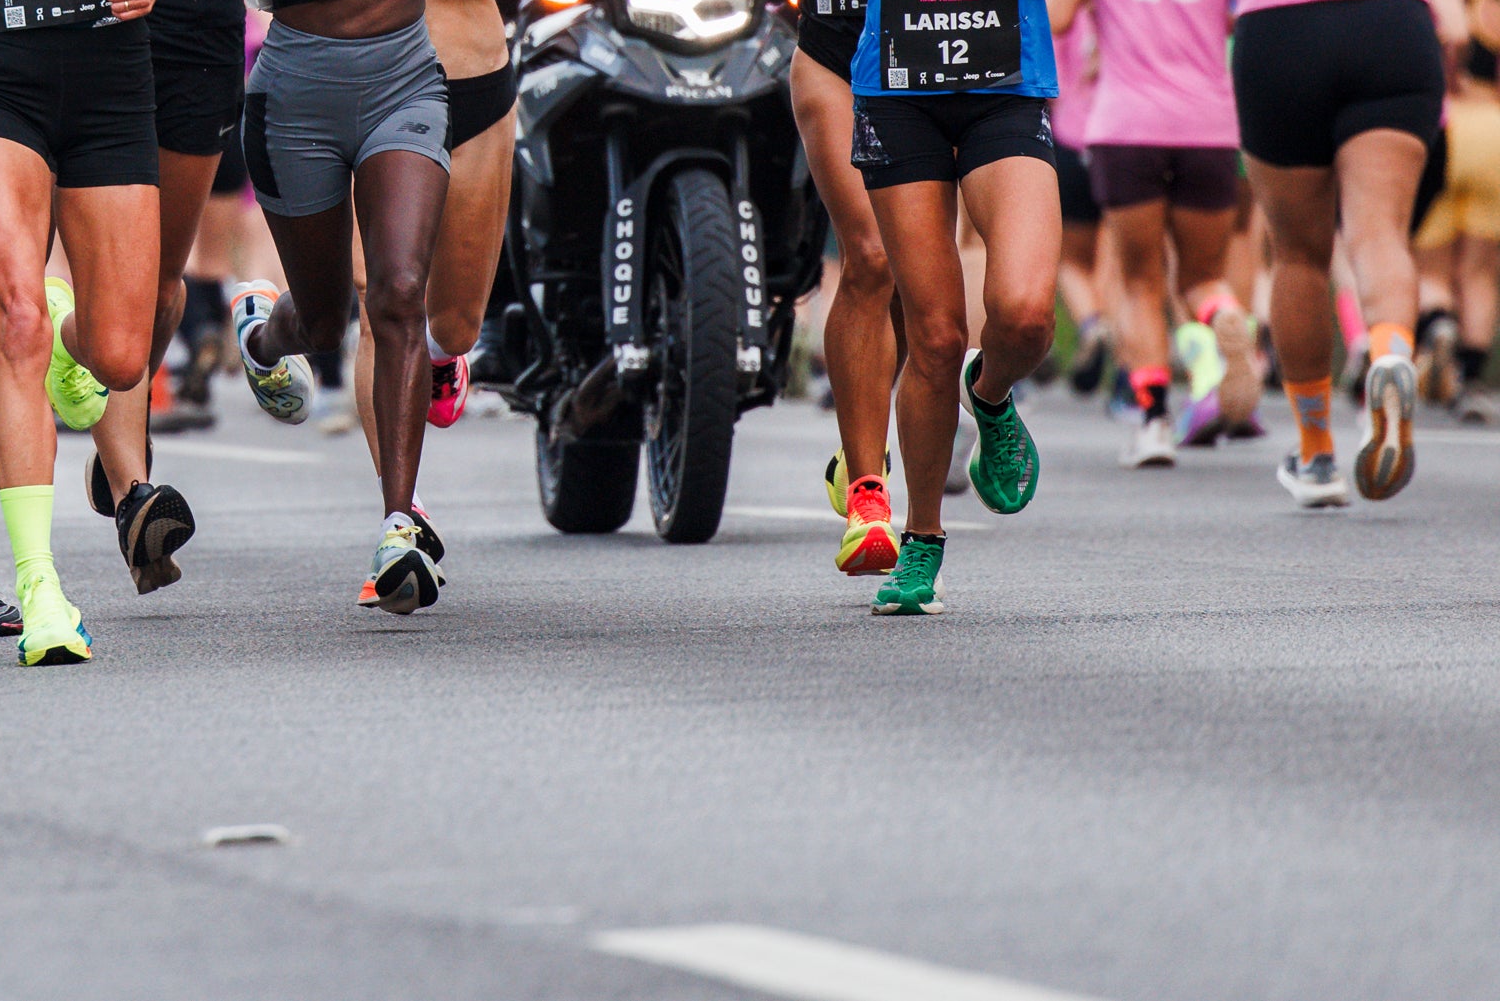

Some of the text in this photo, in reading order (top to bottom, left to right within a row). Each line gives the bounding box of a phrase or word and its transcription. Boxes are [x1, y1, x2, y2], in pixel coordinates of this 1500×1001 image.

[904, 10, 1001, 31] LARISSA
[938, 39, 969, 65] 12
[963, 73, 980, 81] Jeep
[613, 198, 635, 325] CHOQUE
[738, 201, 763, 328] CHOQUE
